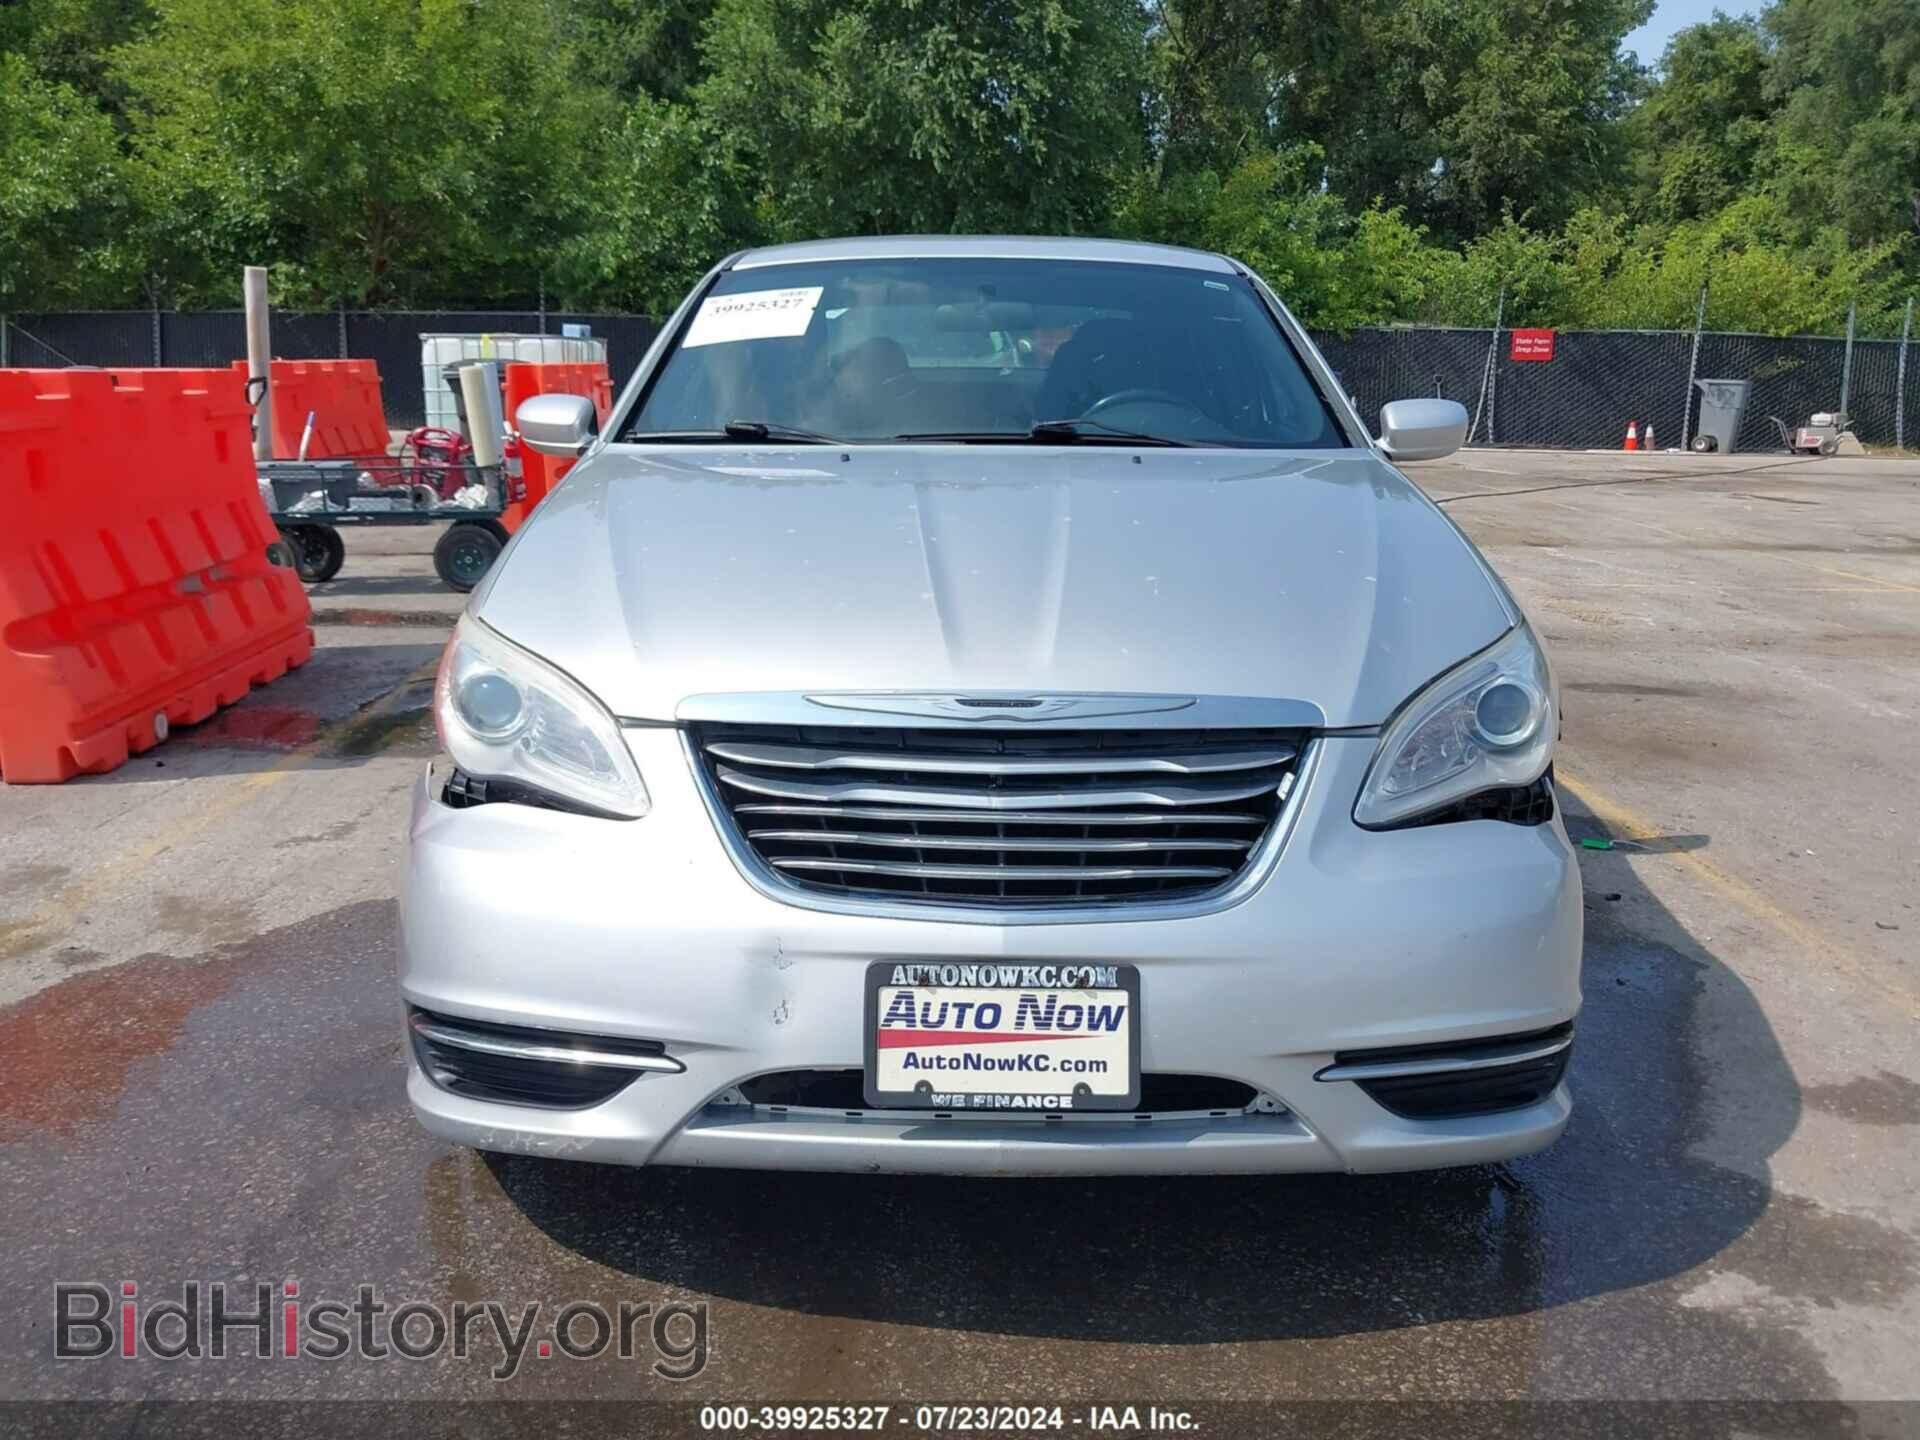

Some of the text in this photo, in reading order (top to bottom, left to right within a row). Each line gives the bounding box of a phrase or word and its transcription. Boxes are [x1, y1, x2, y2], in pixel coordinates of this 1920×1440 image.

[890, 964, 1118, 988] AUTONOWKC.COM
[902, 1051, 1108, 1073] AutoNowKC.com
[931, 1094, 1073, 1109] WE FINANCE
